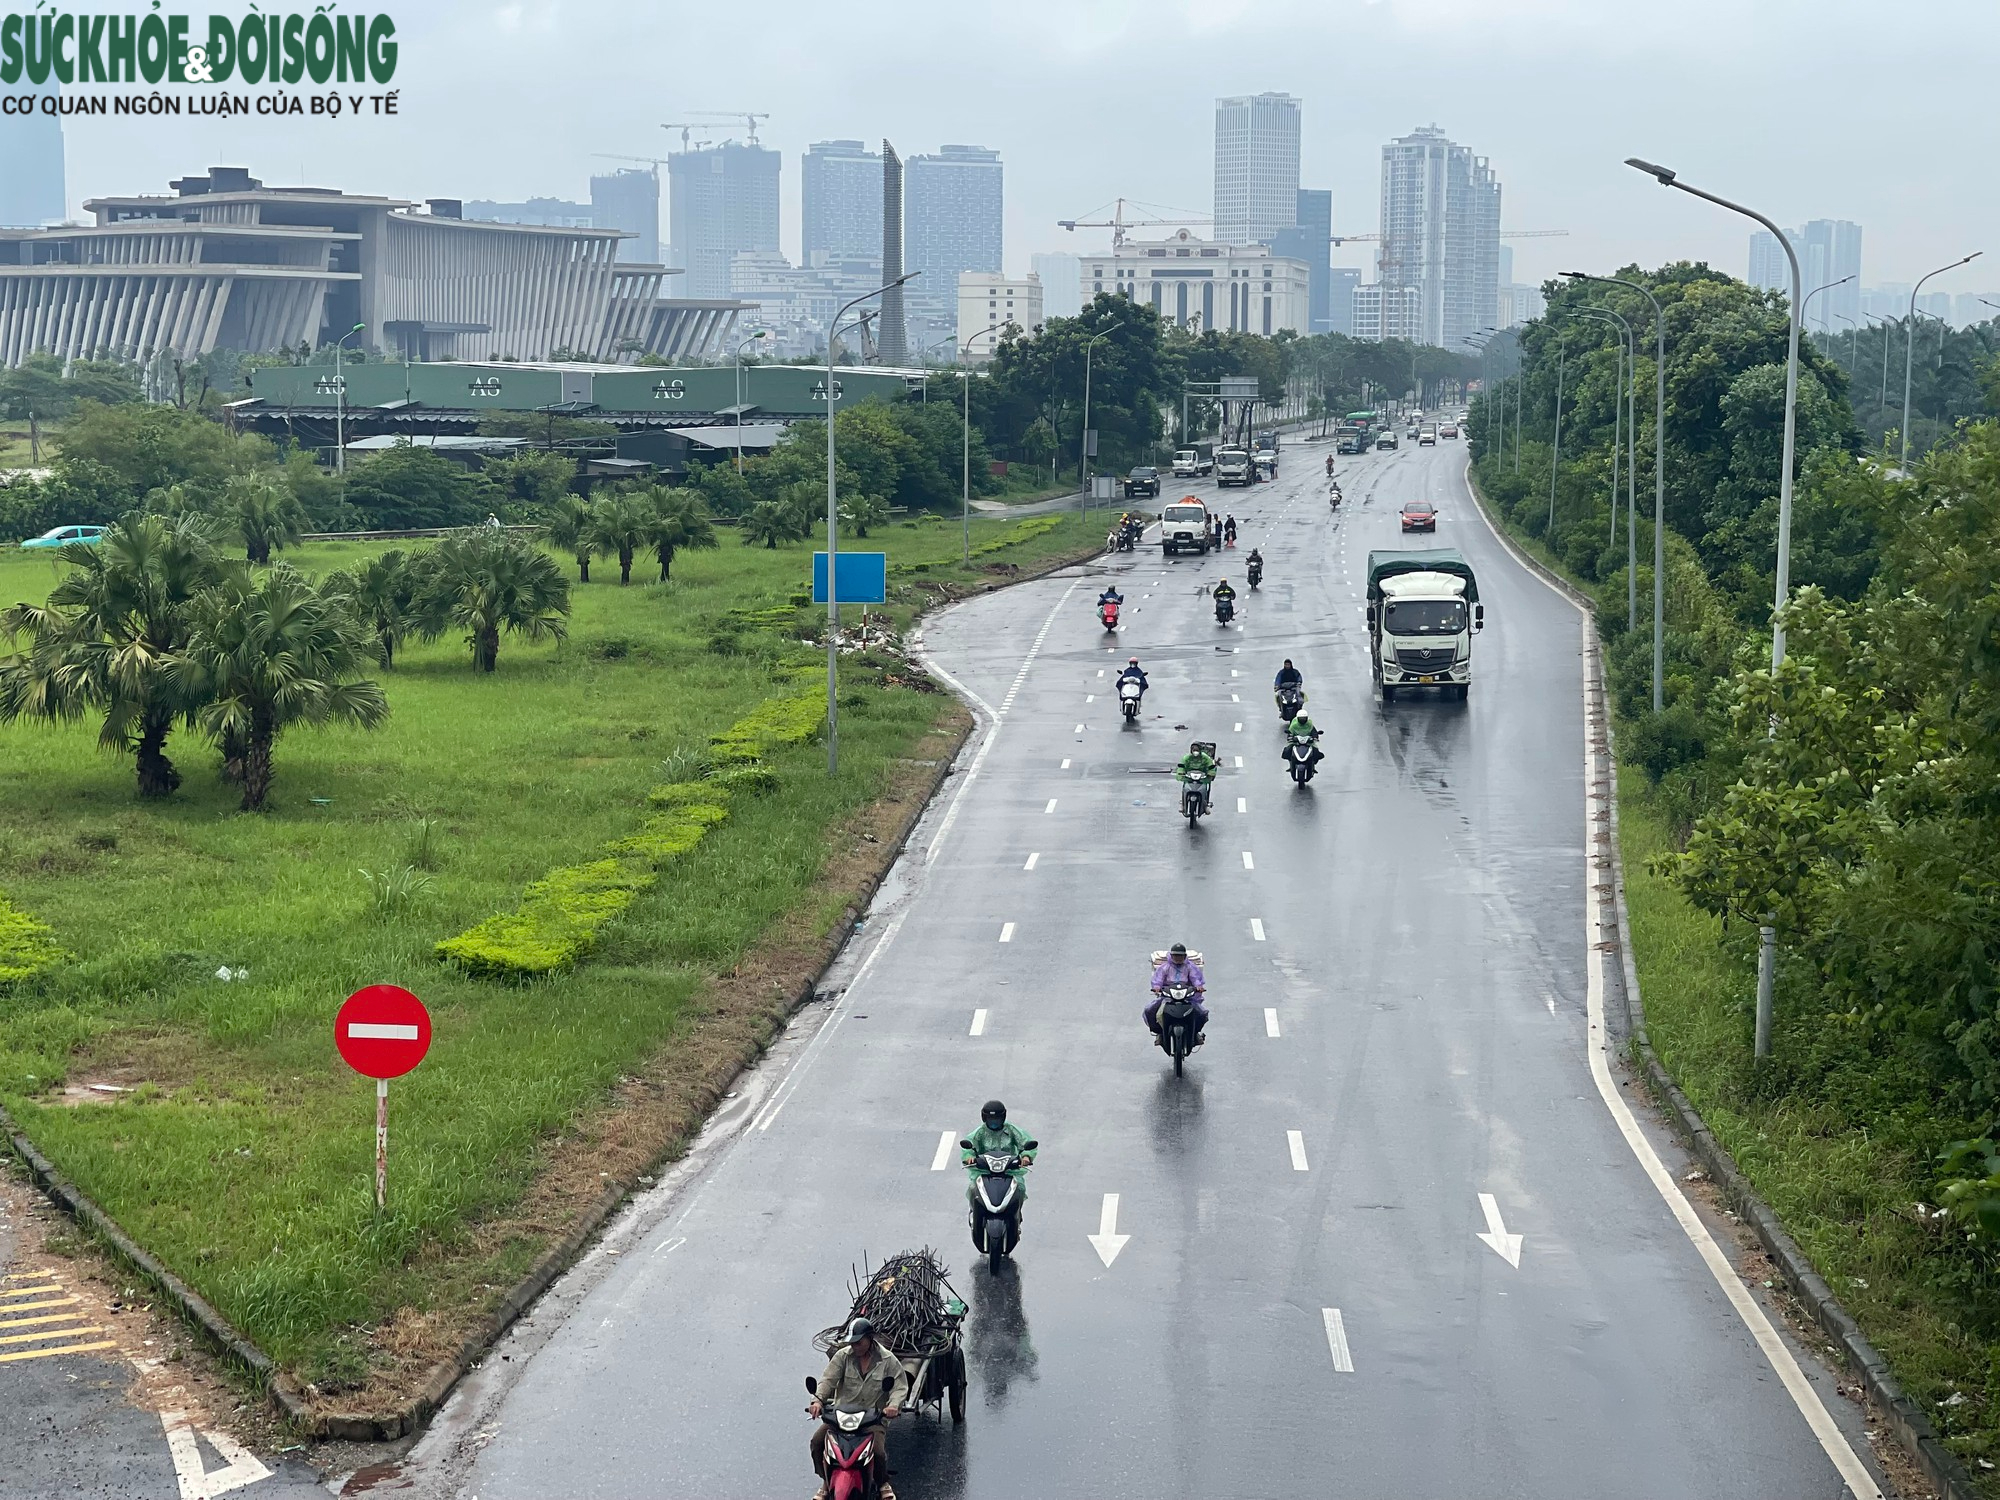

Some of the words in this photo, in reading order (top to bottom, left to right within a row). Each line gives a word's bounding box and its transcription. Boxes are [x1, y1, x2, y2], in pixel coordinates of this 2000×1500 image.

[316, 375, 345, 394] AS
[470, 376, 500, 396] AS
[654, 379, 684, 399] AS
